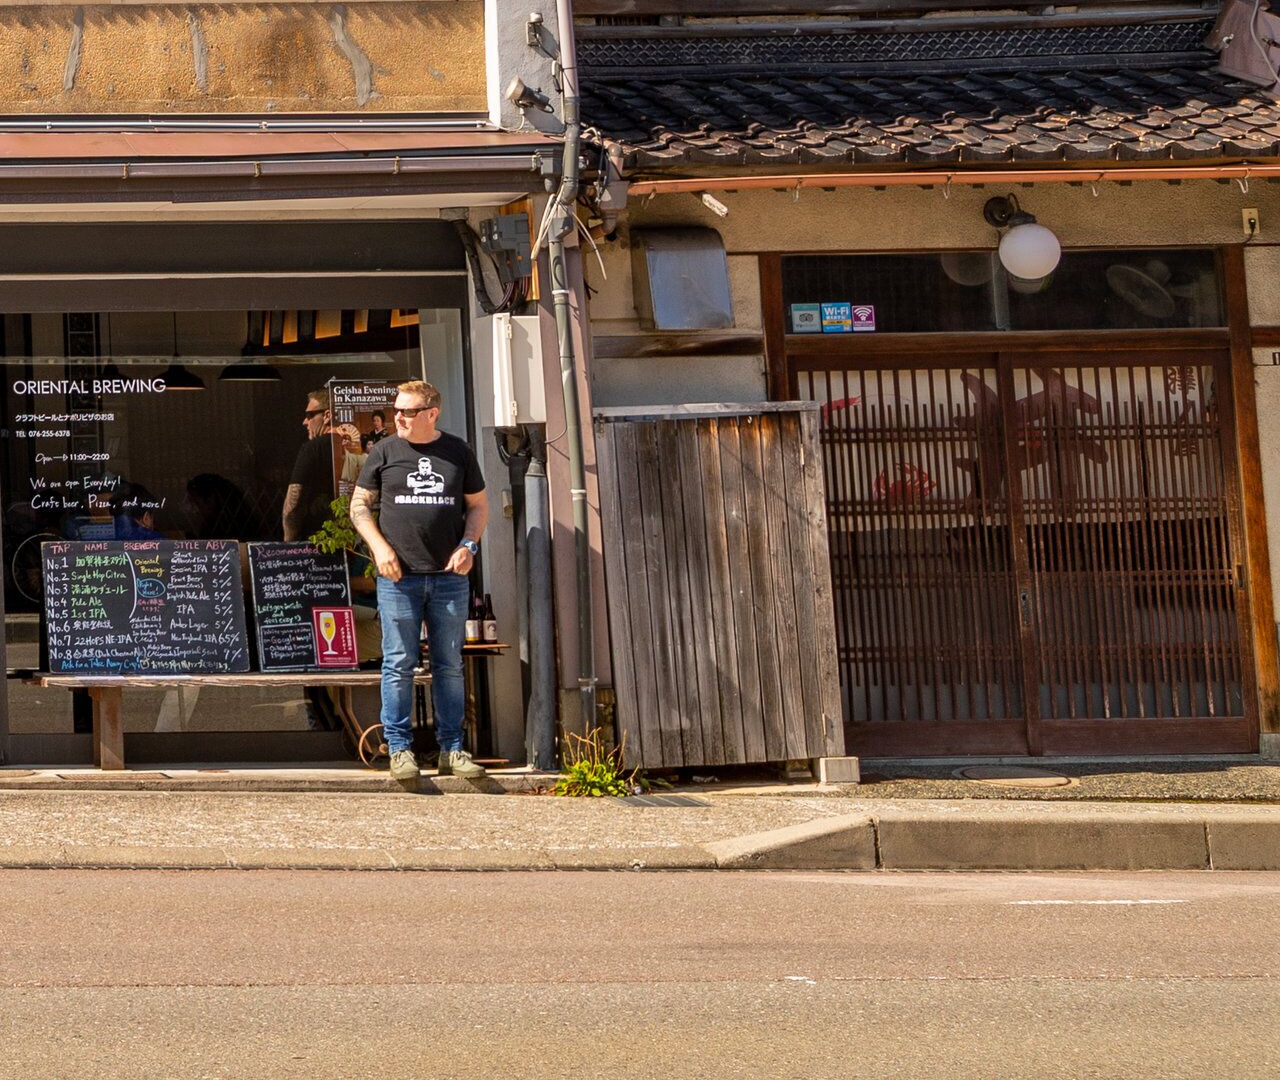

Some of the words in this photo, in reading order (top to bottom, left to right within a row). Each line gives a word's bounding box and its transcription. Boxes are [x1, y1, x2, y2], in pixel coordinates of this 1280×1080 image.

[13, 380, 88, 395] ORIENTAL
[92, 378, 167, 394] BREWING
[333, 386, 362, 395] Geisha
[334, 394, 343, 402] in
[344, 393, 387, 402] Kanazawa
[30, 477, 46, 490] We
[65, 481, 79, 489] open
[31, 494, 59, 509] Craft
[122, 496, 138, 507] and
[395, 495, 456, 505] #BACKBLACK
[50, 543, 70, 554] TAP
[84, 542, 109, 551] NAME
[123, 541, 160, 551] BREWERY
[174, 542, 200, 550] STYLE
[205, 541, 226, 550] ABV
[46, 556, 69, 570] No.1
[192, 563, 208, 573] IPA
[46, 572, 70, 583] No.2
[47, 608, 69, 619] No.5
[88, 607, 107, 618] IPA
[176, 604, 195, 614] IPA
[214, 604, 233, 616] 5%
[48, 620, 71, 633] No.6
[214, 617, 233, 632] 5%
[49, 634, 71, 646] No.7
[271, 634, 295, 644] Google
[49, 647, 73, 660] No.8
